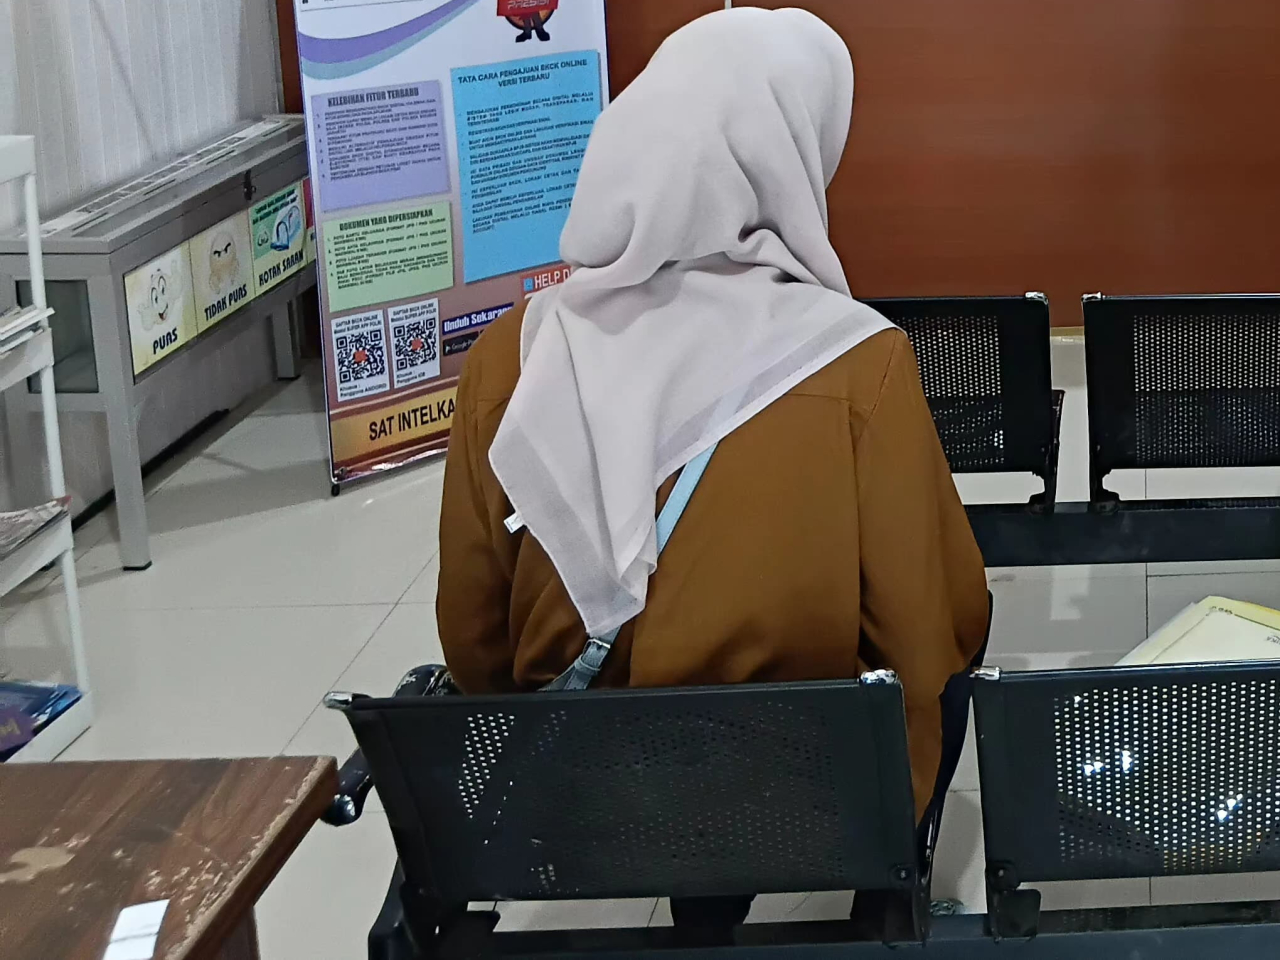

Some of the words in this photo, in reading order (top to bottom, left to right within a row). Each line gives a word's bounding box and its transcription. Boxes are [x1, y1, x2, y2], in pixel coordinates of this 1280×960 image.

[458, 75, 477, 84] TATA
[478, 72, 499, 82] CARA
[499, 65, 540, 78] PENGAJUAN
[540, 62, 560, 71] SKCK
[560, 59, 588, 69] ONLINE
[498, 77, 518, 88] VERSI
[518, 72, 550, 85] TERBARU
[327, 96, 365, 108] KELEBIHAN
[366, 91, 387, 103] FITUR
[387, 87, 419, 99] TERBARU
[339, 218, 370, 231] DOKUMEN
[388, 209, 433, 223] DIPERSIAPKAN
[258, 264, 282, 287] KOTAK
[282, 248, 305, 271] SARAN
[534, 271, 560, 289] HELP
[204, 296, 227, 321] TIDAK
[228, 284, 248, 306] PUAS
[444, 317, 470, 332] Unduh
[152, 327, 178, 355] PUAS
[369, 415, 394, 441] SAT
